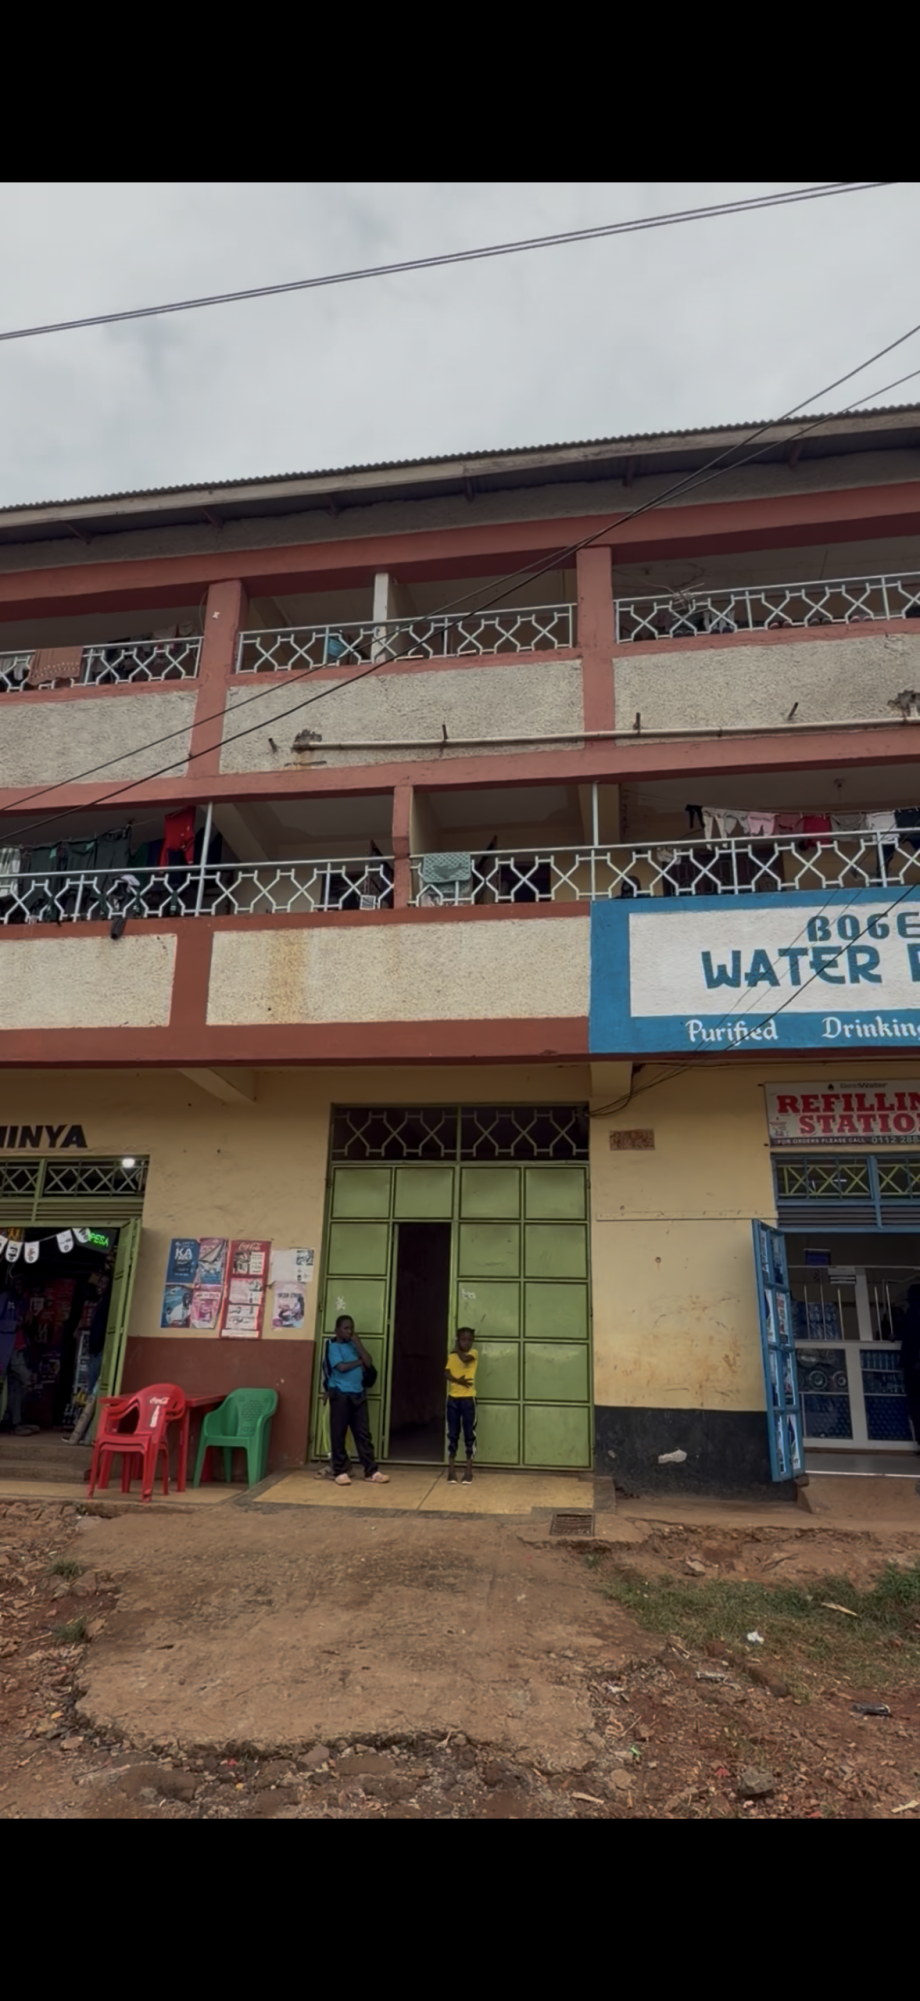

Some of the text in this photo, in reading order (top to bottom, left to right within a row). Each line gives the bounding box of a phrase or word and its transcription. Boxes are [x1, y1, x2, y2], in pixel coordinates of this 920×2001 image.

[701, 945, 883, 989] WATER
[685, 1014, 920, 1046] Purified Drinkin
[0, 1124, 88, 1149] INYA
[798, 1112, 920, 1135] STATIO
